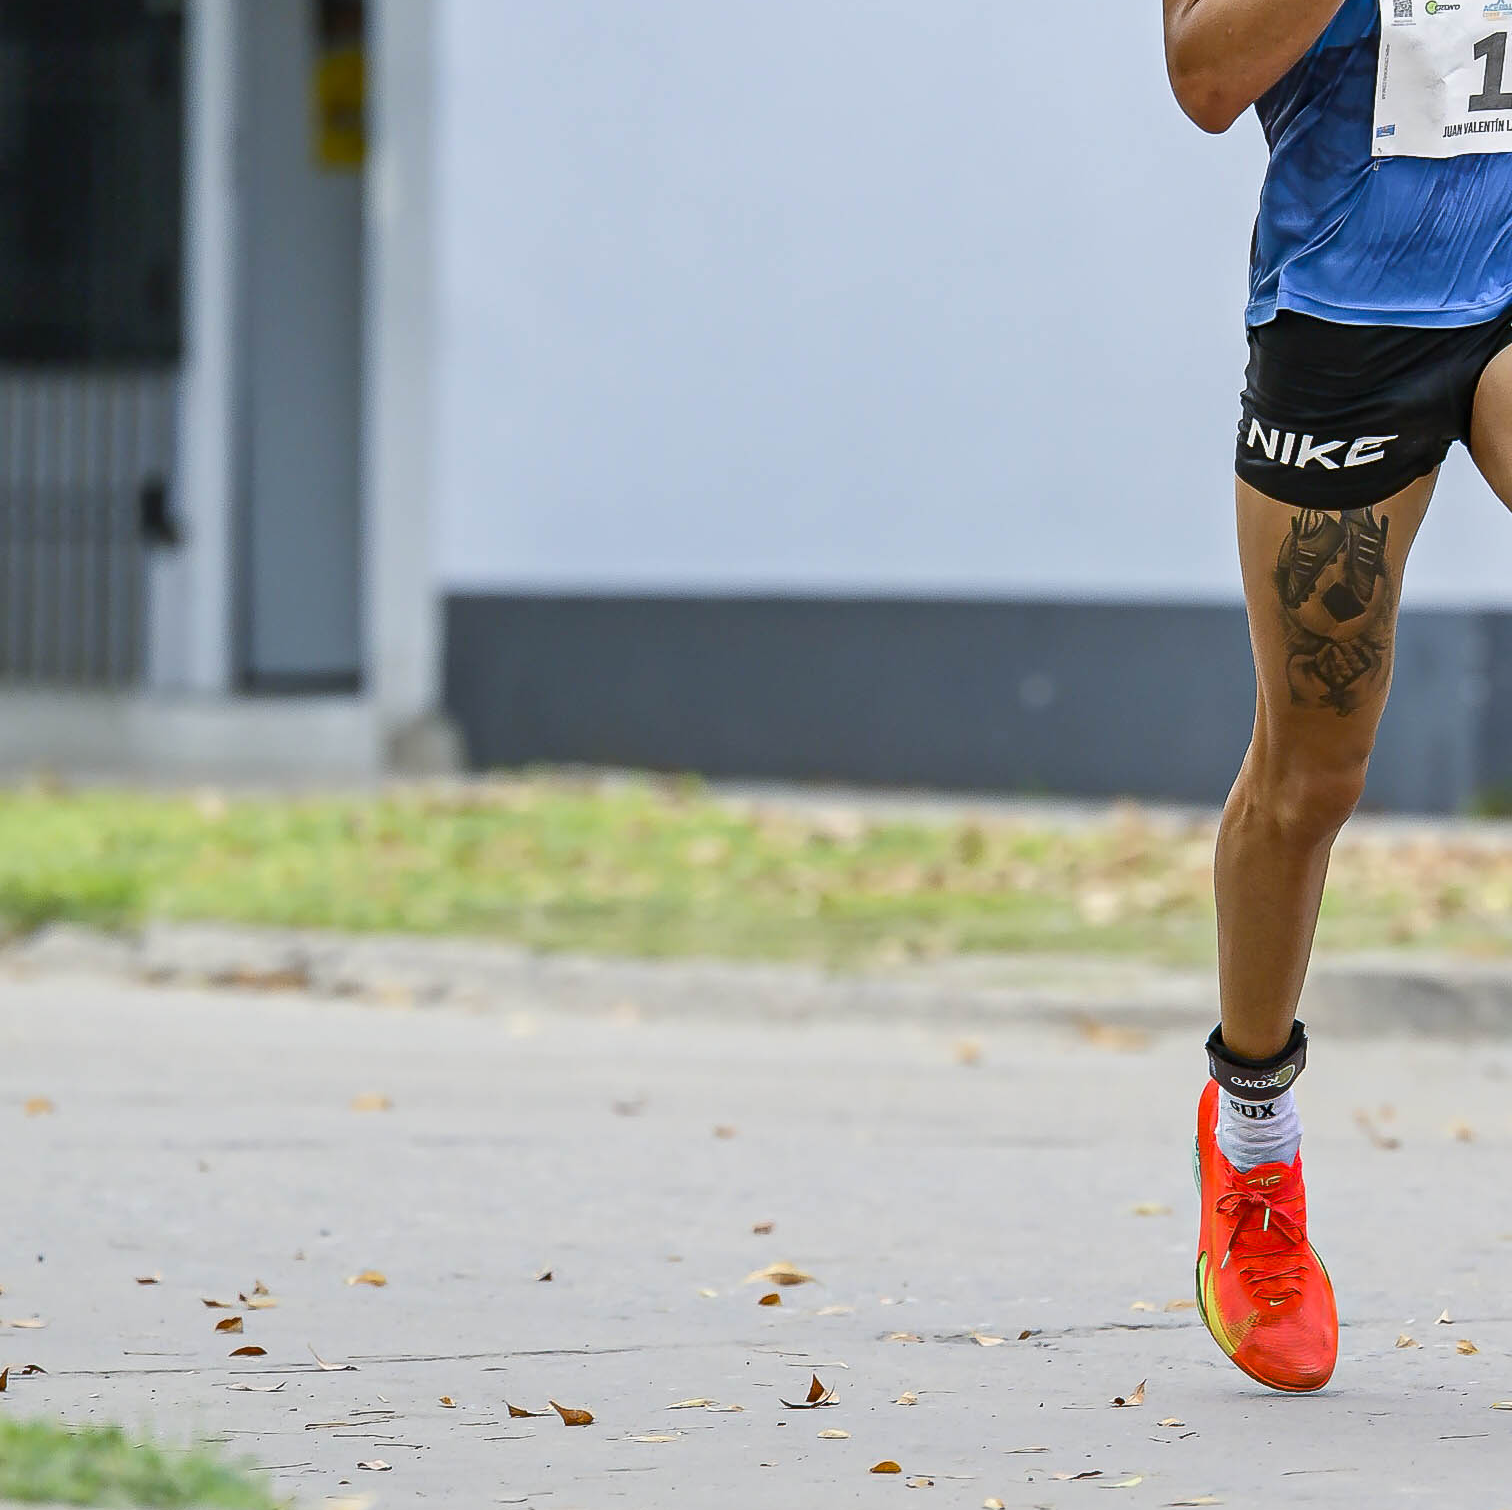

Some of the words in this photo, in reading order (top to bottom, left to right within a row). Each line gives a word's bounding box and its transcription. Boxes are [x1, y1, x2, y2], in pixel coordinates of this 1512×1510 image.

[1442, 123, 1463, 138] JUAN
[1463, 118, 1505, 134] VALENTÍN
[1247, 417, 1399, 469] NIKE
